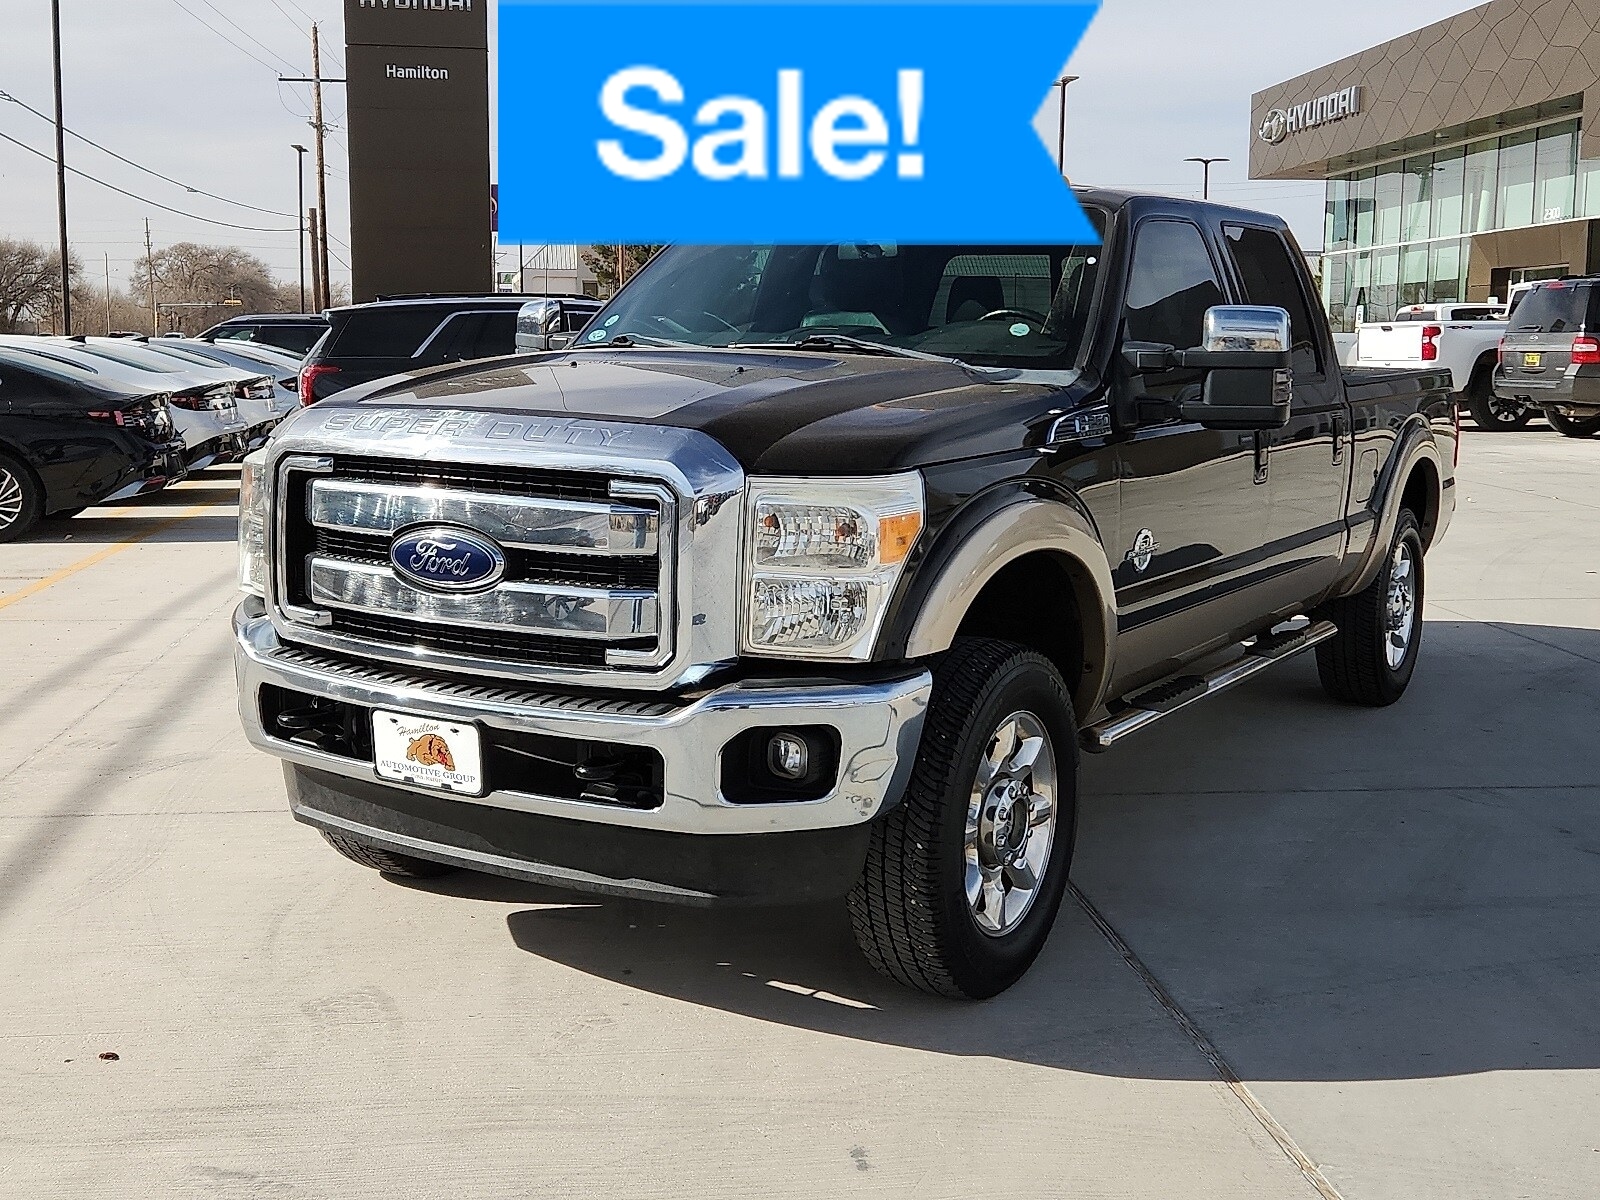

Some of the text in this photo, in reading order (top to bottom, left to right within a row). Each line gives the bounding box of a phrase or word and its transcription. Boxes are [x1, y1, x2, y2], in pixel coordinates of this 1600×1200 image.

[386, 64, 449, 80] Hamilton
[1286, 85, 1361, 133] HYUNDAI
[323, 412, 634, 447] SUPER DUTY
[409, 539, 472, 577] Ford
[396, 722, 440, 737] Hamilton
[380, 760, 441, 778] AUTOMOTIVE
[443, 771, 476, 783] GROUP
